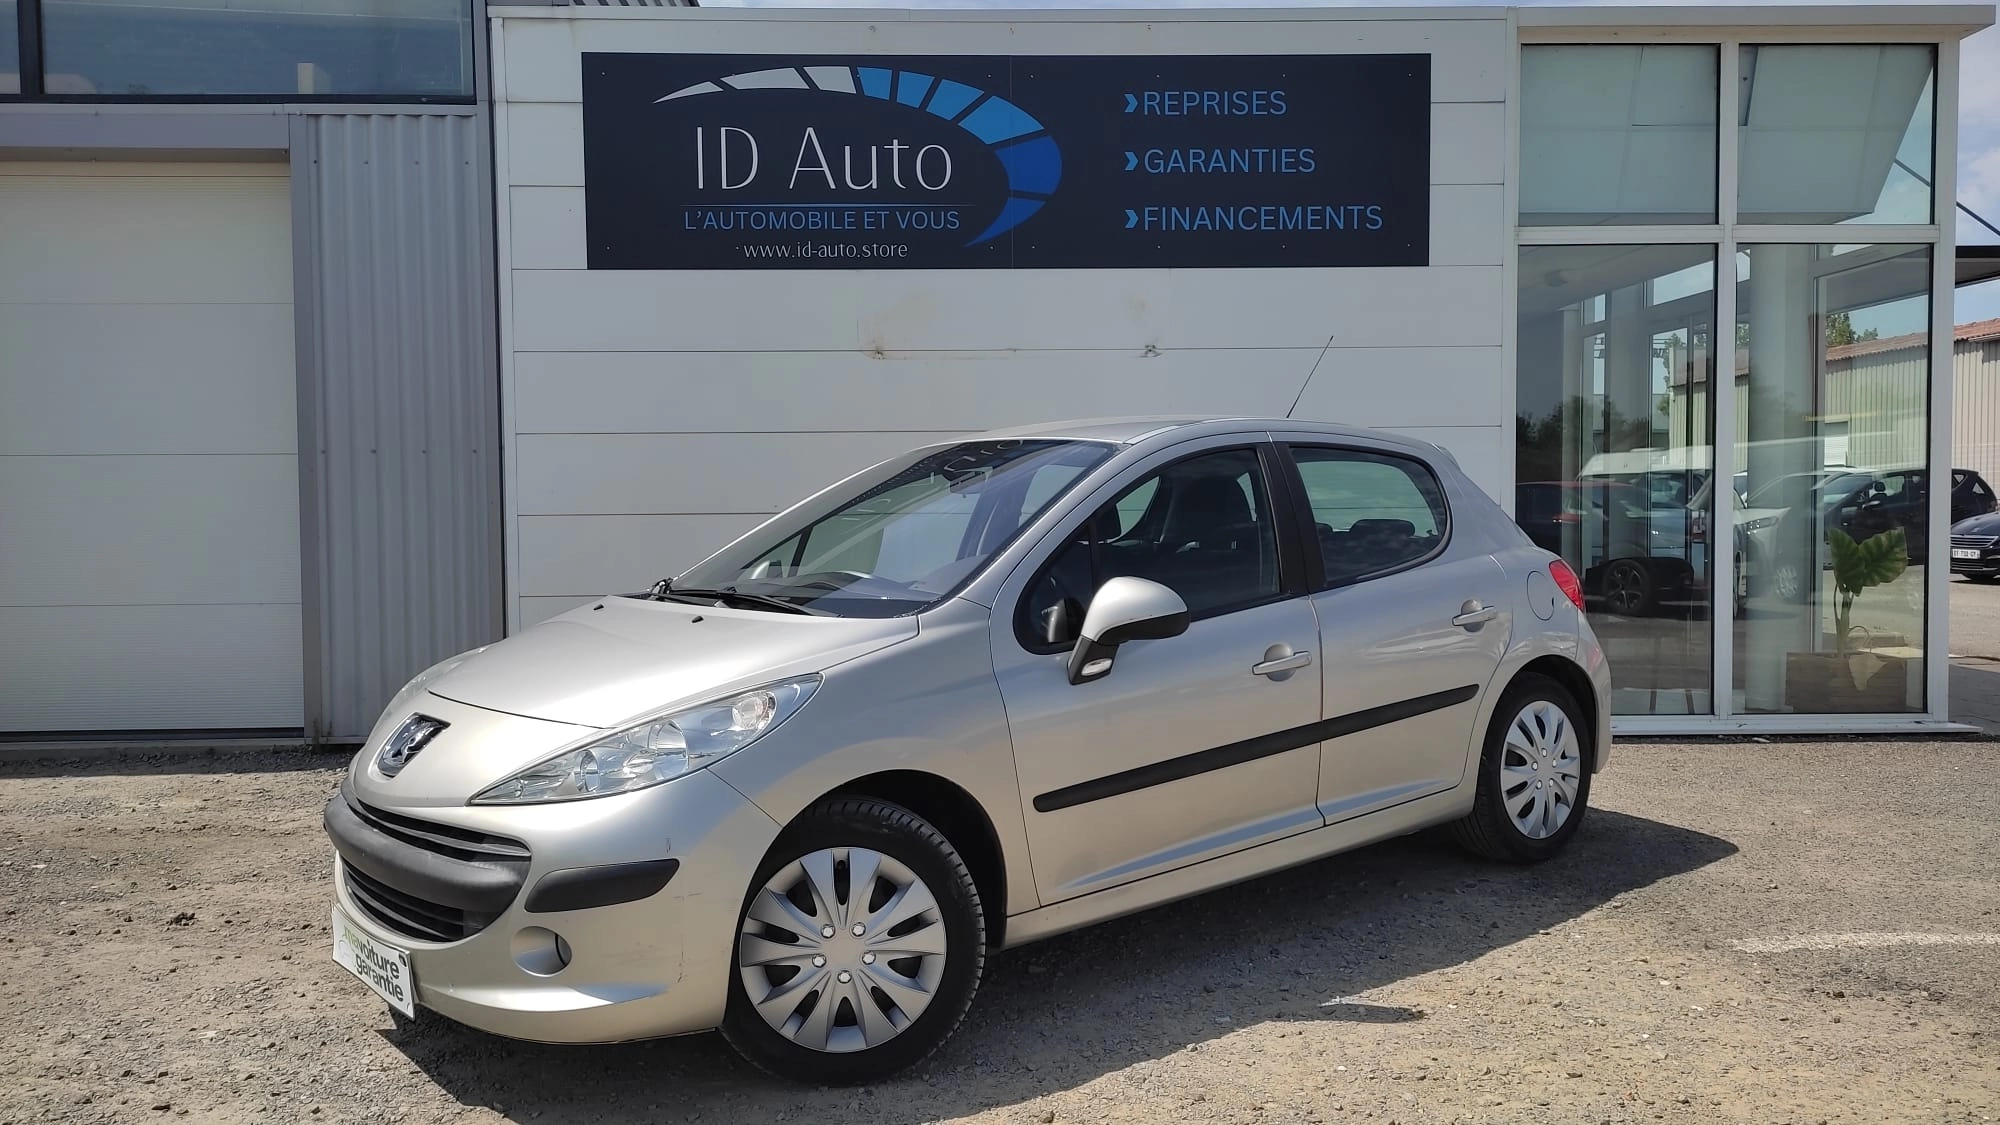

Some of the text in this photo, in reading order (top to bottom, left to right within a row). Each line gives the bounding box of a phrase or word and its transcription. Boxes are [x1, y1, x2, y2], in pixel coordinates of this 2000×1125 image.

[1144, 90, 1287, 116] REPRISES
[697, 126, 953, 190] ID Auto
[1144, 148, 1316, 174] GARANTIES
[684, 210, 960, 230] L’AUTOMOBILE ET VOUS
[1144, 205, 1383, 231] FINANCEMENTS
[743, 240, 908, 258] www.id-auto.store
[355, 954, 403, 1001] garantie
